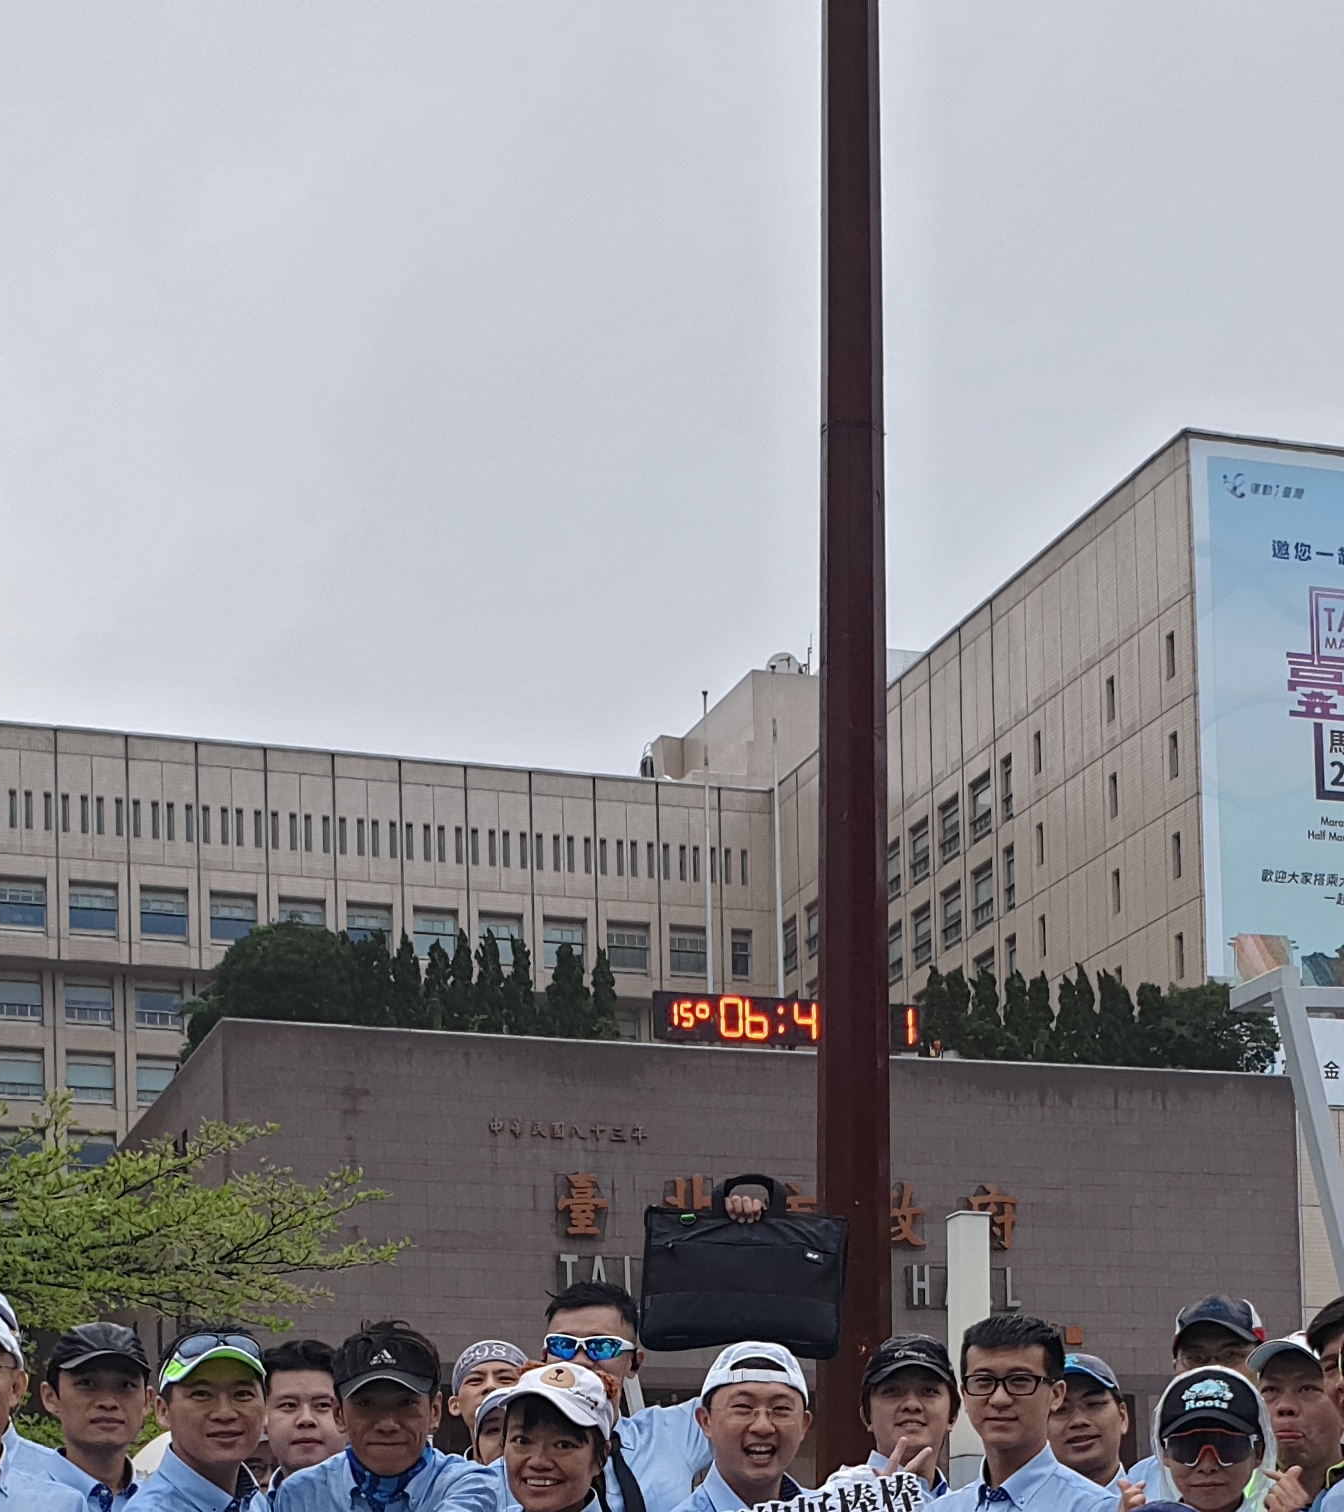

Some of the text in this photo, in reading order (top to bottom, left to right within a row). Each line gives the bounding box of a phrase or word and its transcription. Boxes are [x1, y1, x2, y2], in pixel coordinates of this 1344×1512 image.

[1308, 830, 1326, 840] Half
[489, 1117, 648, 1146] 中華民國八十三年
[1185, 1399, 1228, 1411] Roots
